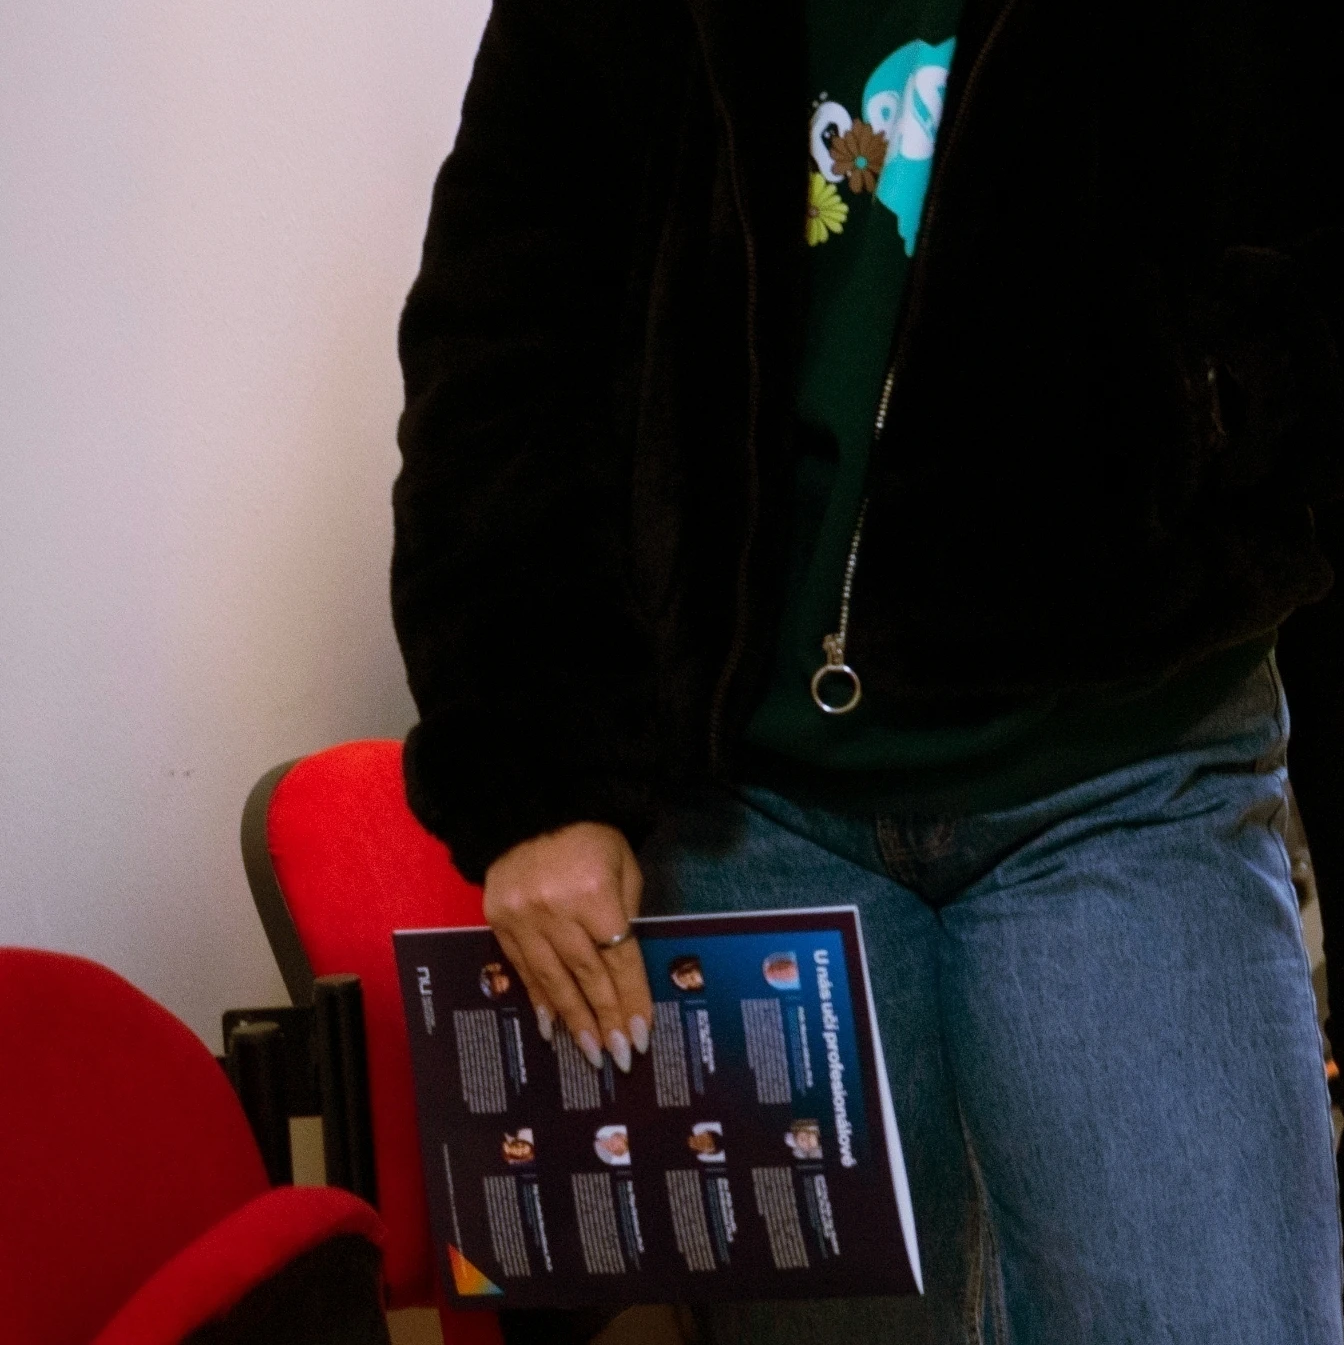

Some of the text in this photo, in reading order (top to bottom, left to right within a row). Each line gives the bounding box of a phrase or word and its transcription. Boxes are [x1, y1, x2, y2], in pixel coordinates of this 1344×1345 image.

[813, 949, 857, 1167] U nás učí profesionálové
